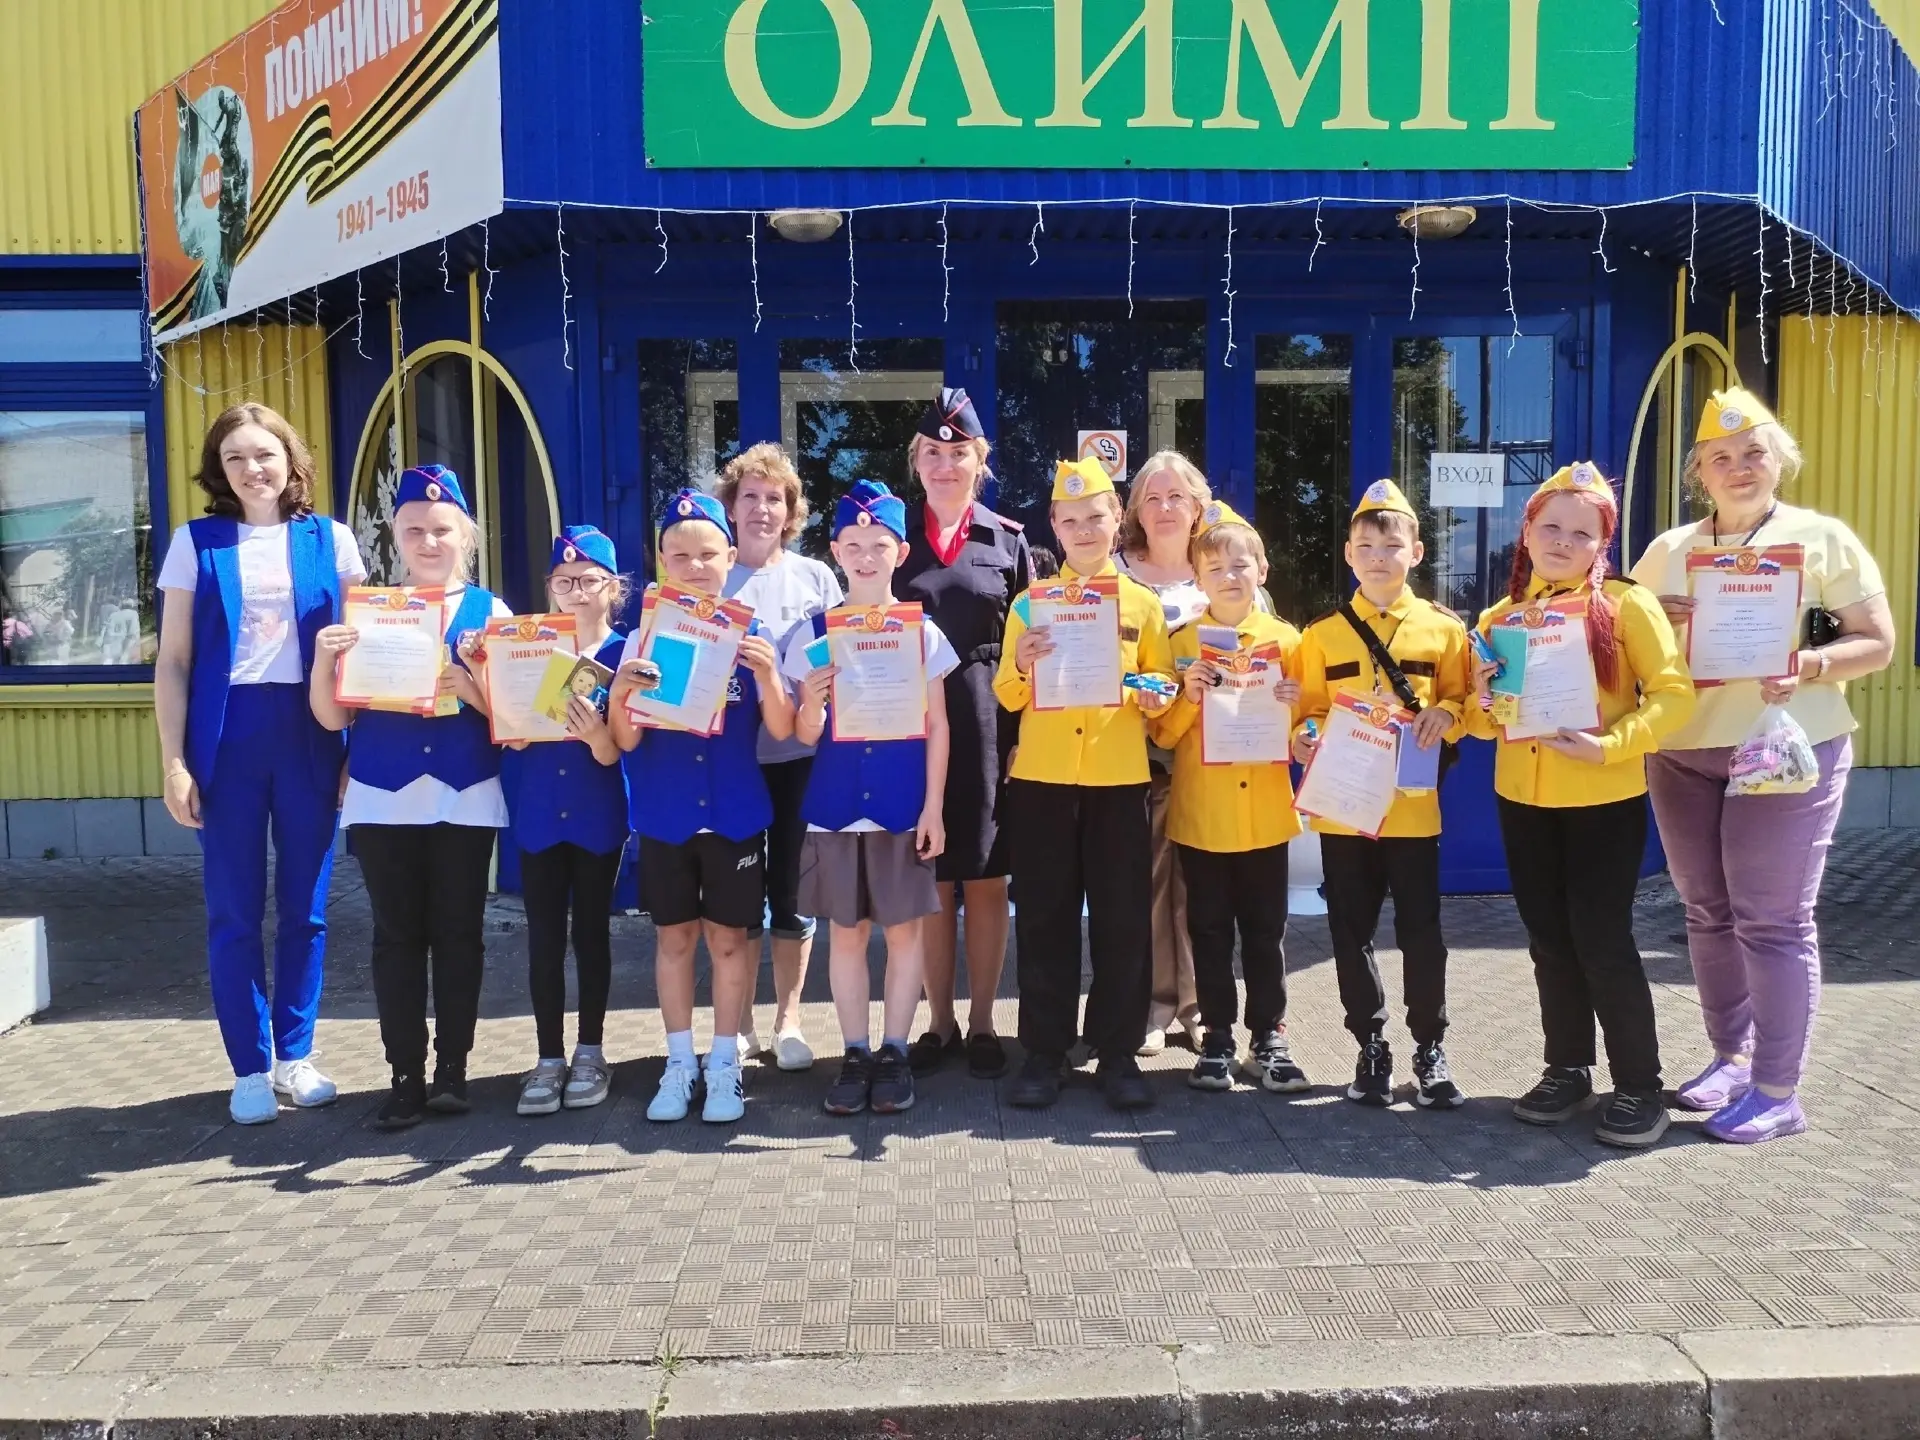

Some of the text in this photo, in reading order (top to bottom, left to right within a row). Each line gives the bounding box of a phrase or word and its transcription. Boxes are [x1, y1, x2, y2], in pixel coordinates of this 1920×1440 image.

[265, 0, 423, 122] ПОМНИМ!
[724, 0, 1555, 130] ОЛИМП
[1437, 466, 1494, 486] ВХОД
[1718, 583, 1772, 595] ДИПЛОМ
[374, 617, 420, 625] ДИПЛОМ
[1052, 612, 1097, 623] ДИПЛОМ
[674, 620, 720, 643] ДИПЛОМ
[853, 640, 899, 652] ДИПЛОМ
[1528, 634, 1562, 648] ПЛОМ
[507, 648, 553, 660] ДИПЛОМ
[1222, 678, 1265, 688] ДИПЛОМ
[1348, 727, 1393, 750] ДИПЛОМ
[736, 852, 758, 871] FILA
